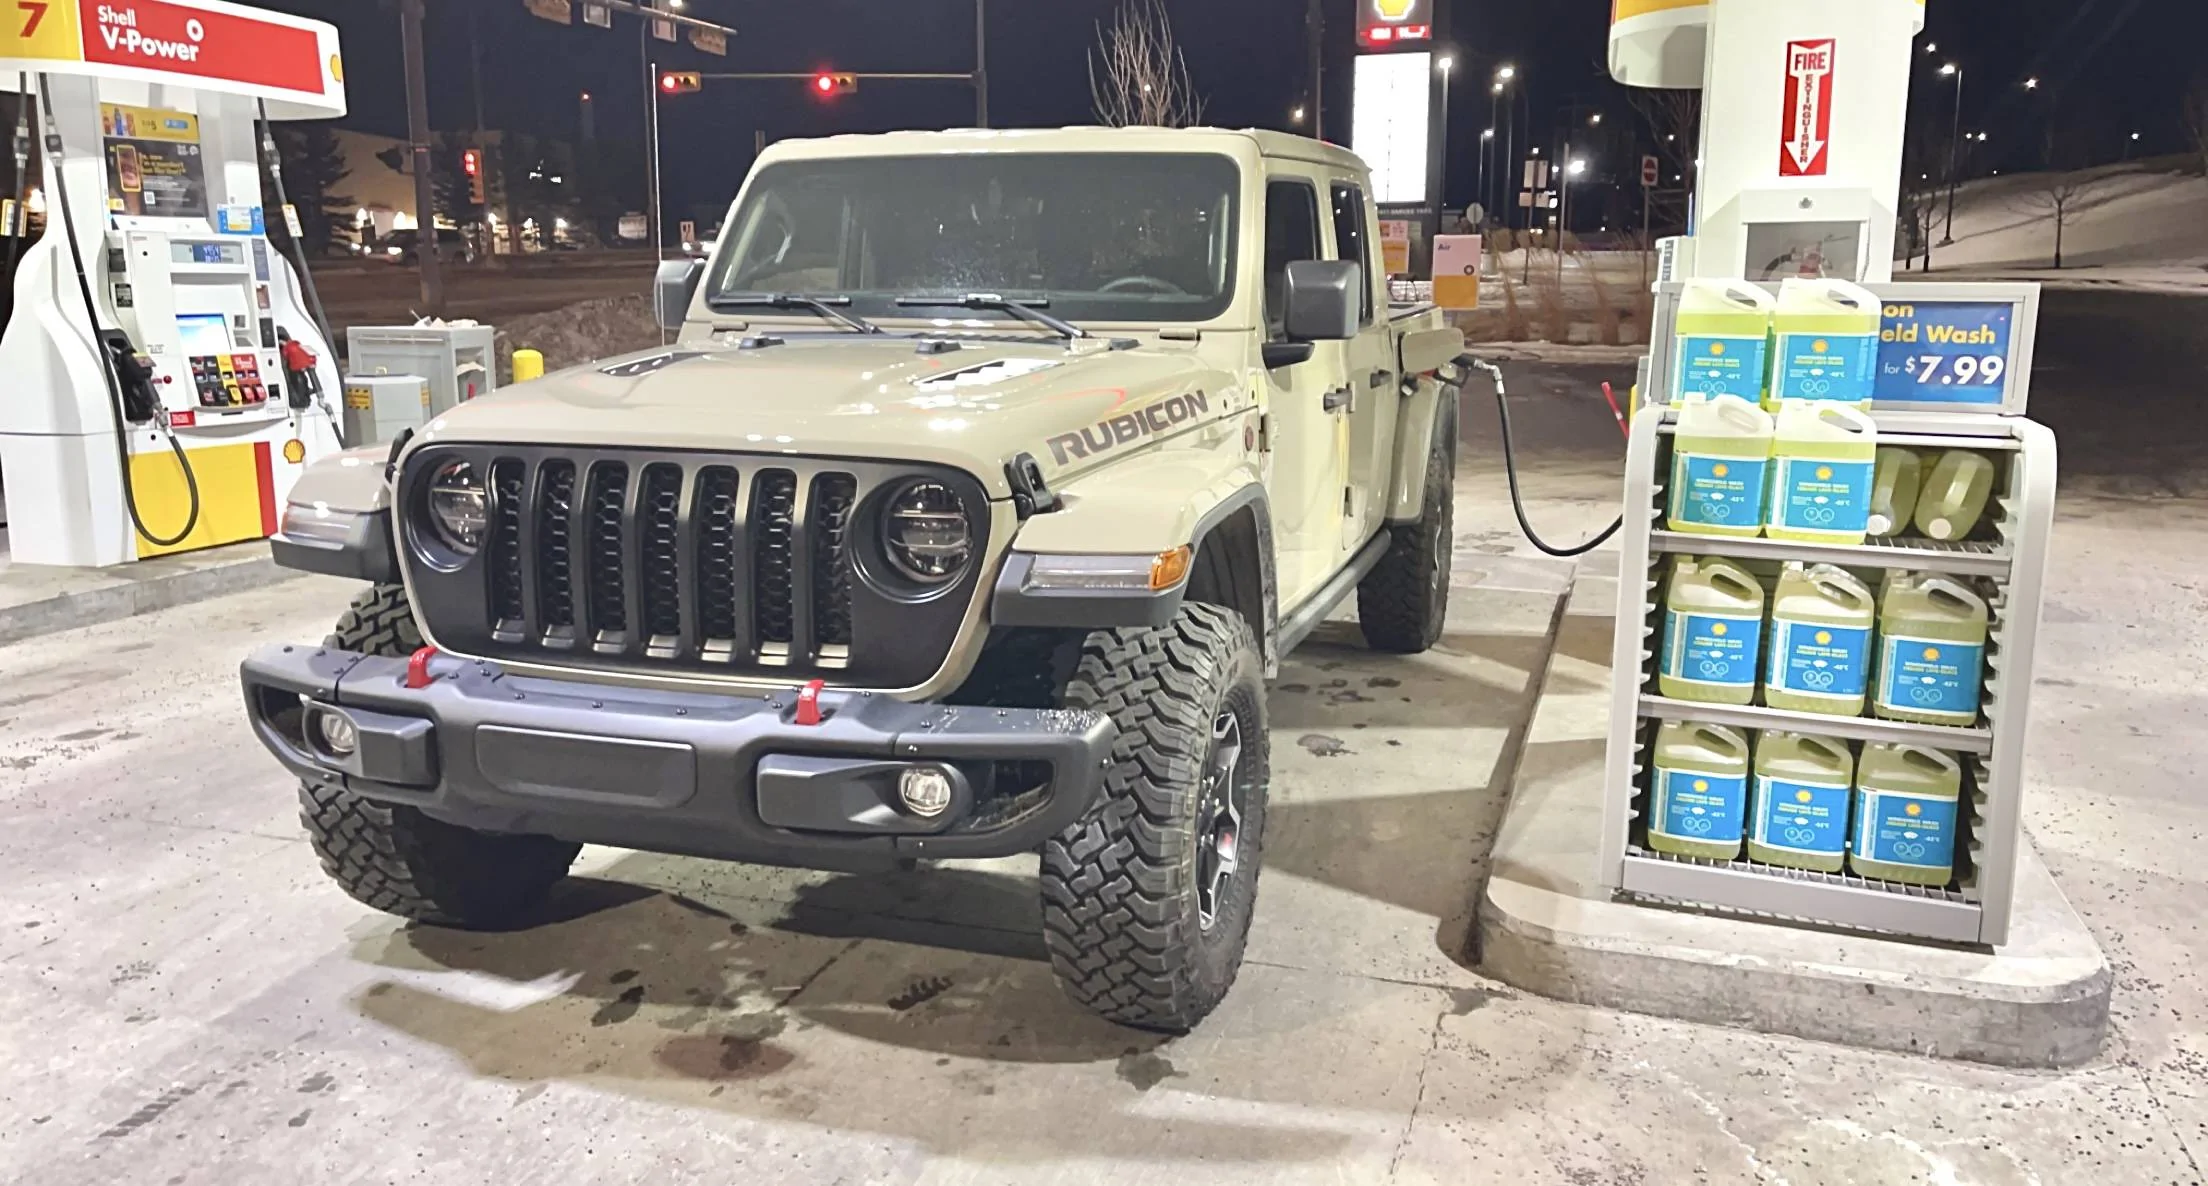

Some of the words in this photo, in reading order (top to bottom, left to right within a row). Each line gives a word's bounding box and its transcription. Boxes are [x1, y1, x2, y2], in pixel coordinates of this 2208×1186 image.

[18, 1, 48, 37] 7
[98, 5, 136, 26] Shell
[100, 25, 199, 61] V-Power
[1795, 52, 1826, 70] FIRE
[1800, 74, 1813, 163] EXTINGUISHER
[1926, 324, 1996, 344] Wash
[1884, 362, 1900, 374] for
[1046, 389, 1208, 466] RUBICON
